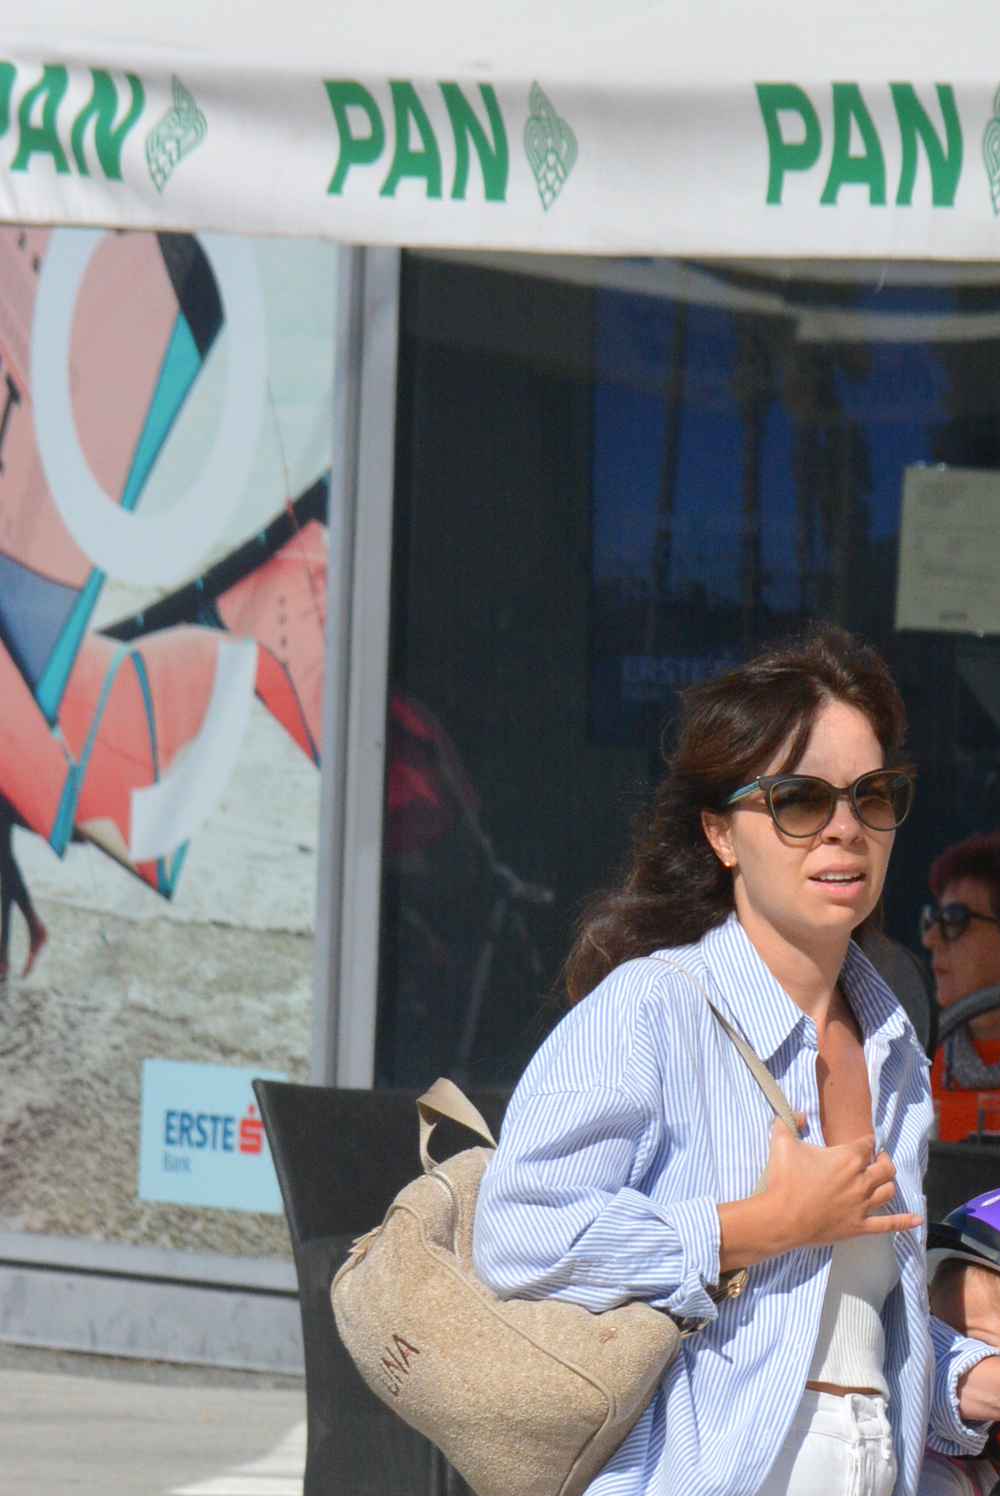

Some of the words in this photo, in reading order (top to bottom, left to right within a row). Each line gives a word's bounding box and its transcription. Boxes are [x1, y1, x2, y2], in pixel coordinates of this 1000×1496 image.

[324, 79, 509, 203] PAN
[754, 81, 963, 207] PAN
[164, 1109, 235, 1153] ERSTE
